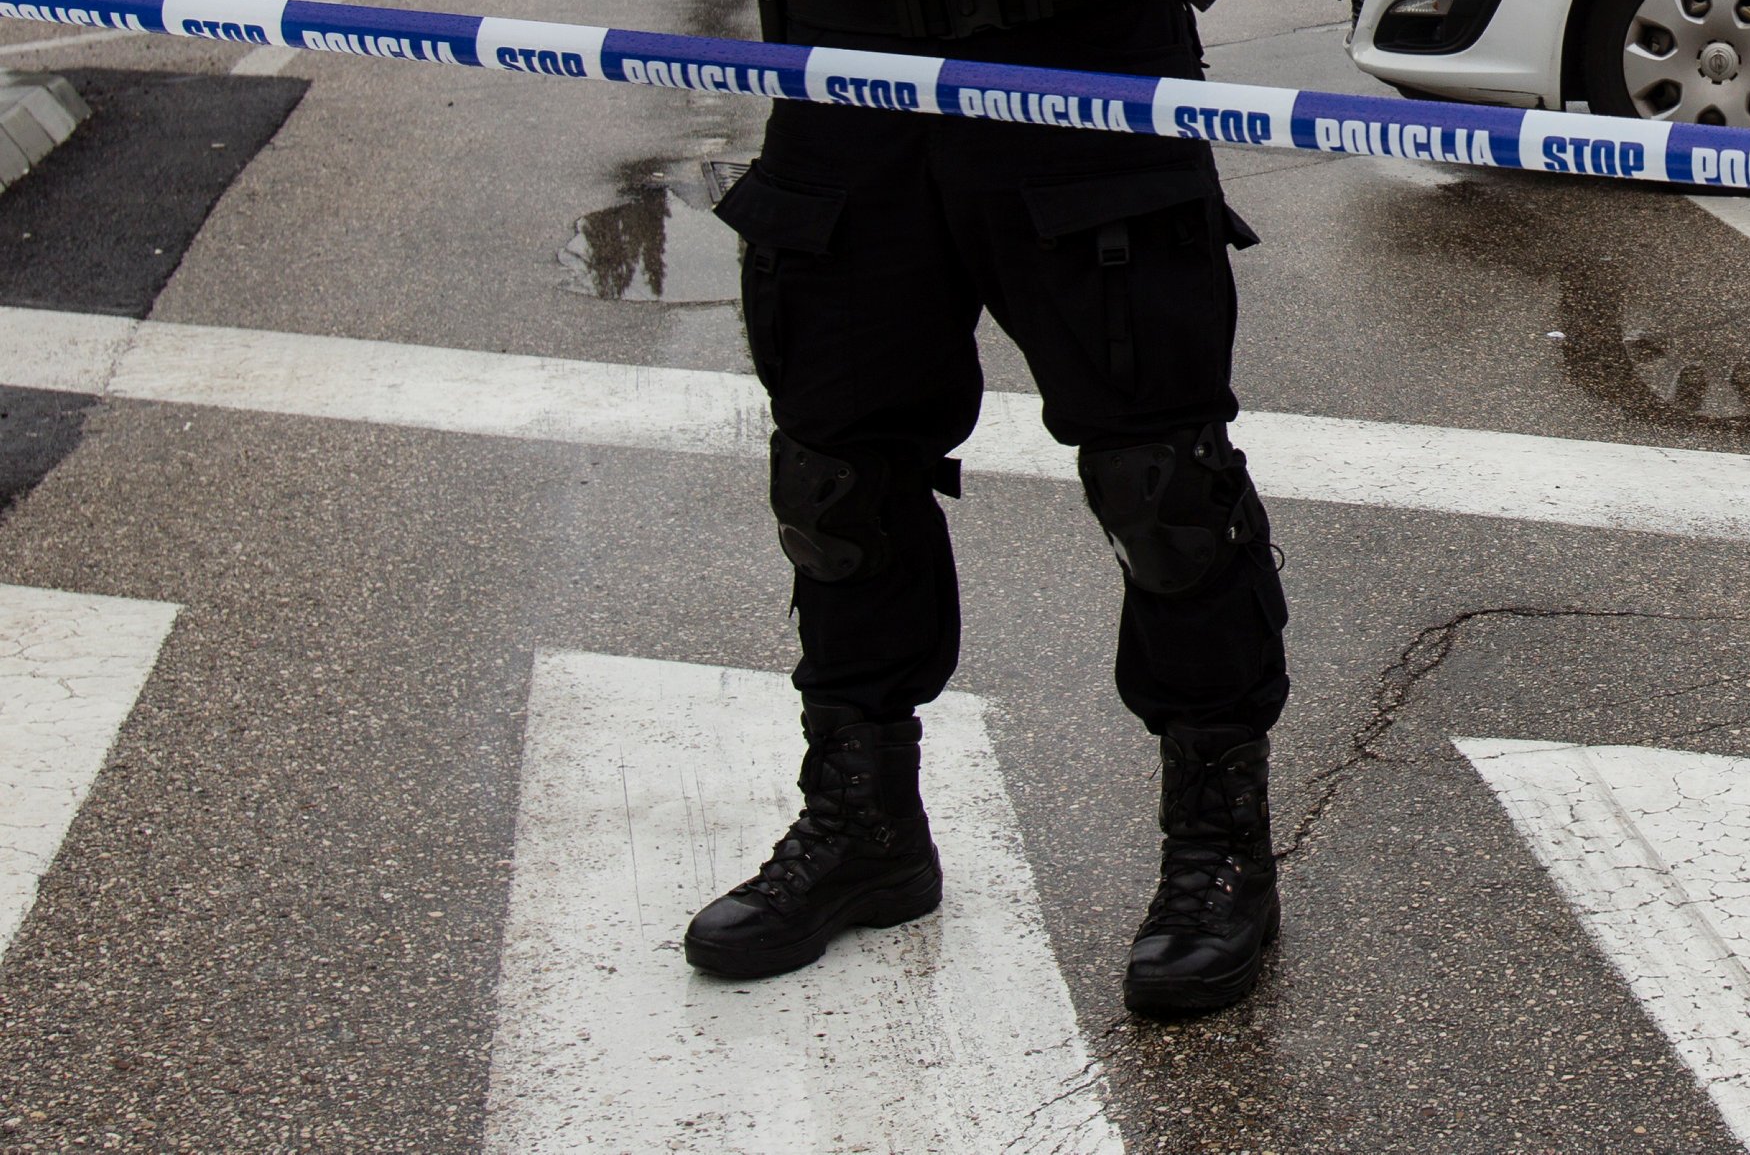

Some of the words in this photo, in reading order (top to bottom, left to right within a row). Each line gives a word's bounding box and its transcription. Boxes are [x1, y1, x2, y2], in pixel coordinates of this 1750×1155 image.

[496, 47, 588, 78] STOP
[622, 58, 789, 99] POLICIJA
[826, 75, 920, 110] STOP
[959, 87, 1135, 133] POLICIJA
[1174, 106, 1271, 144] STOP
[1315, 118, 1500, 166] POLICIJA
[1542, 136, 1645, 177] STOP
